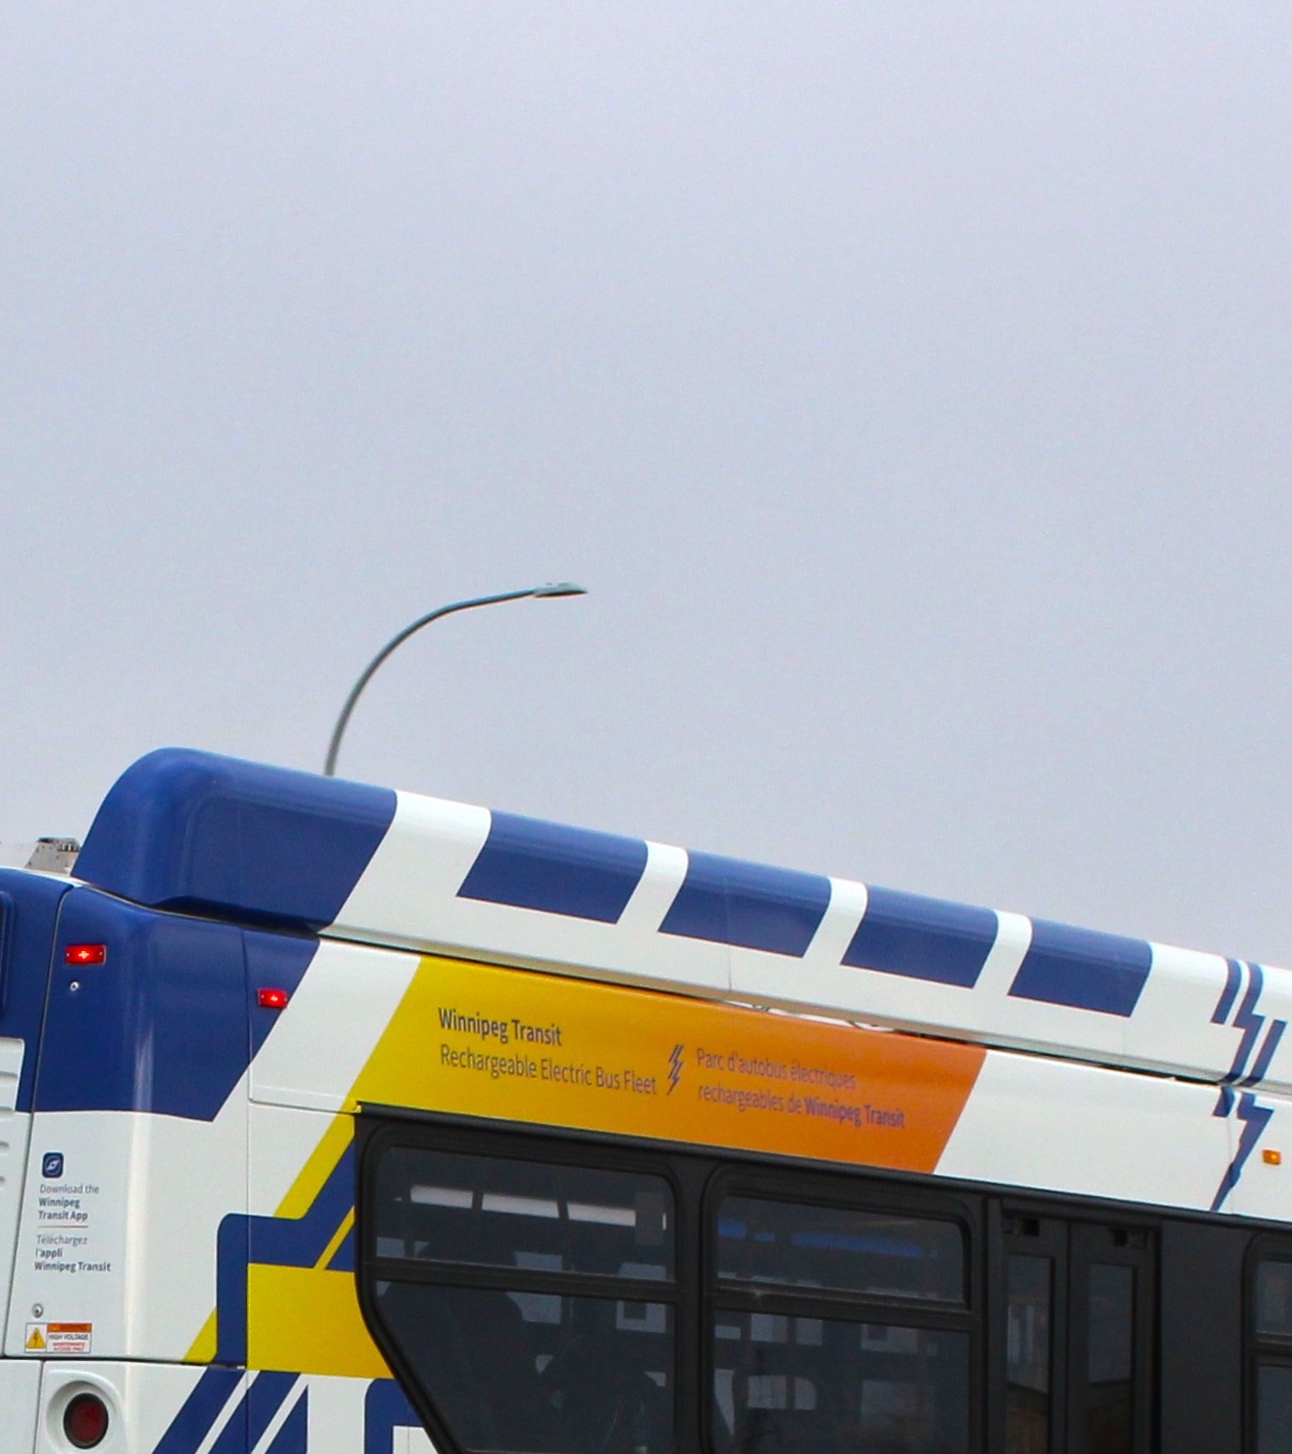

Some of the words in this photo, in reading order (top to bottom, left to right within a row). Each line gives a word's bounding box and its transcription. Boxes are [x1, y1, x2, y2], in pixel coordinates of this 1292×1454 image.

[438, 1007, 510, 1045] Winnipeg
[511, 1018, 563, 1047] Transit
[440, 1043, 538, 1080] Rechargeable
[540, 1057, 592, 1087] Electric
[595, 1065, 621, 1091] Bus
[623, 1069, 658, 1096] Fleet
[695, 1047, 723, 1071] Parc
[727, 1053, 789, 1081] d'autobus
[790, 1059, 856, 1090] électriques
[698, 1082, 785, 1113] rechargeables
[787, 1092, 803, 1114] de
[804, 1094, 863, 1127] Winnipeg
[864, 1104, 906, 1129] Transit
[39, 1183, 83, 1195] Download
[84, 1184, 100, 1195] the
[38, 1197, 81, 1209] Winnipeg
[38, 1209, 69, 1221] Transit
[70, 1211, 89, 1222] App
[35, 1247, 63, 1258] l'appli
[34, 1260, 76, 1273] Winnipeg
[77, 1260, 112, 1272] Transit
